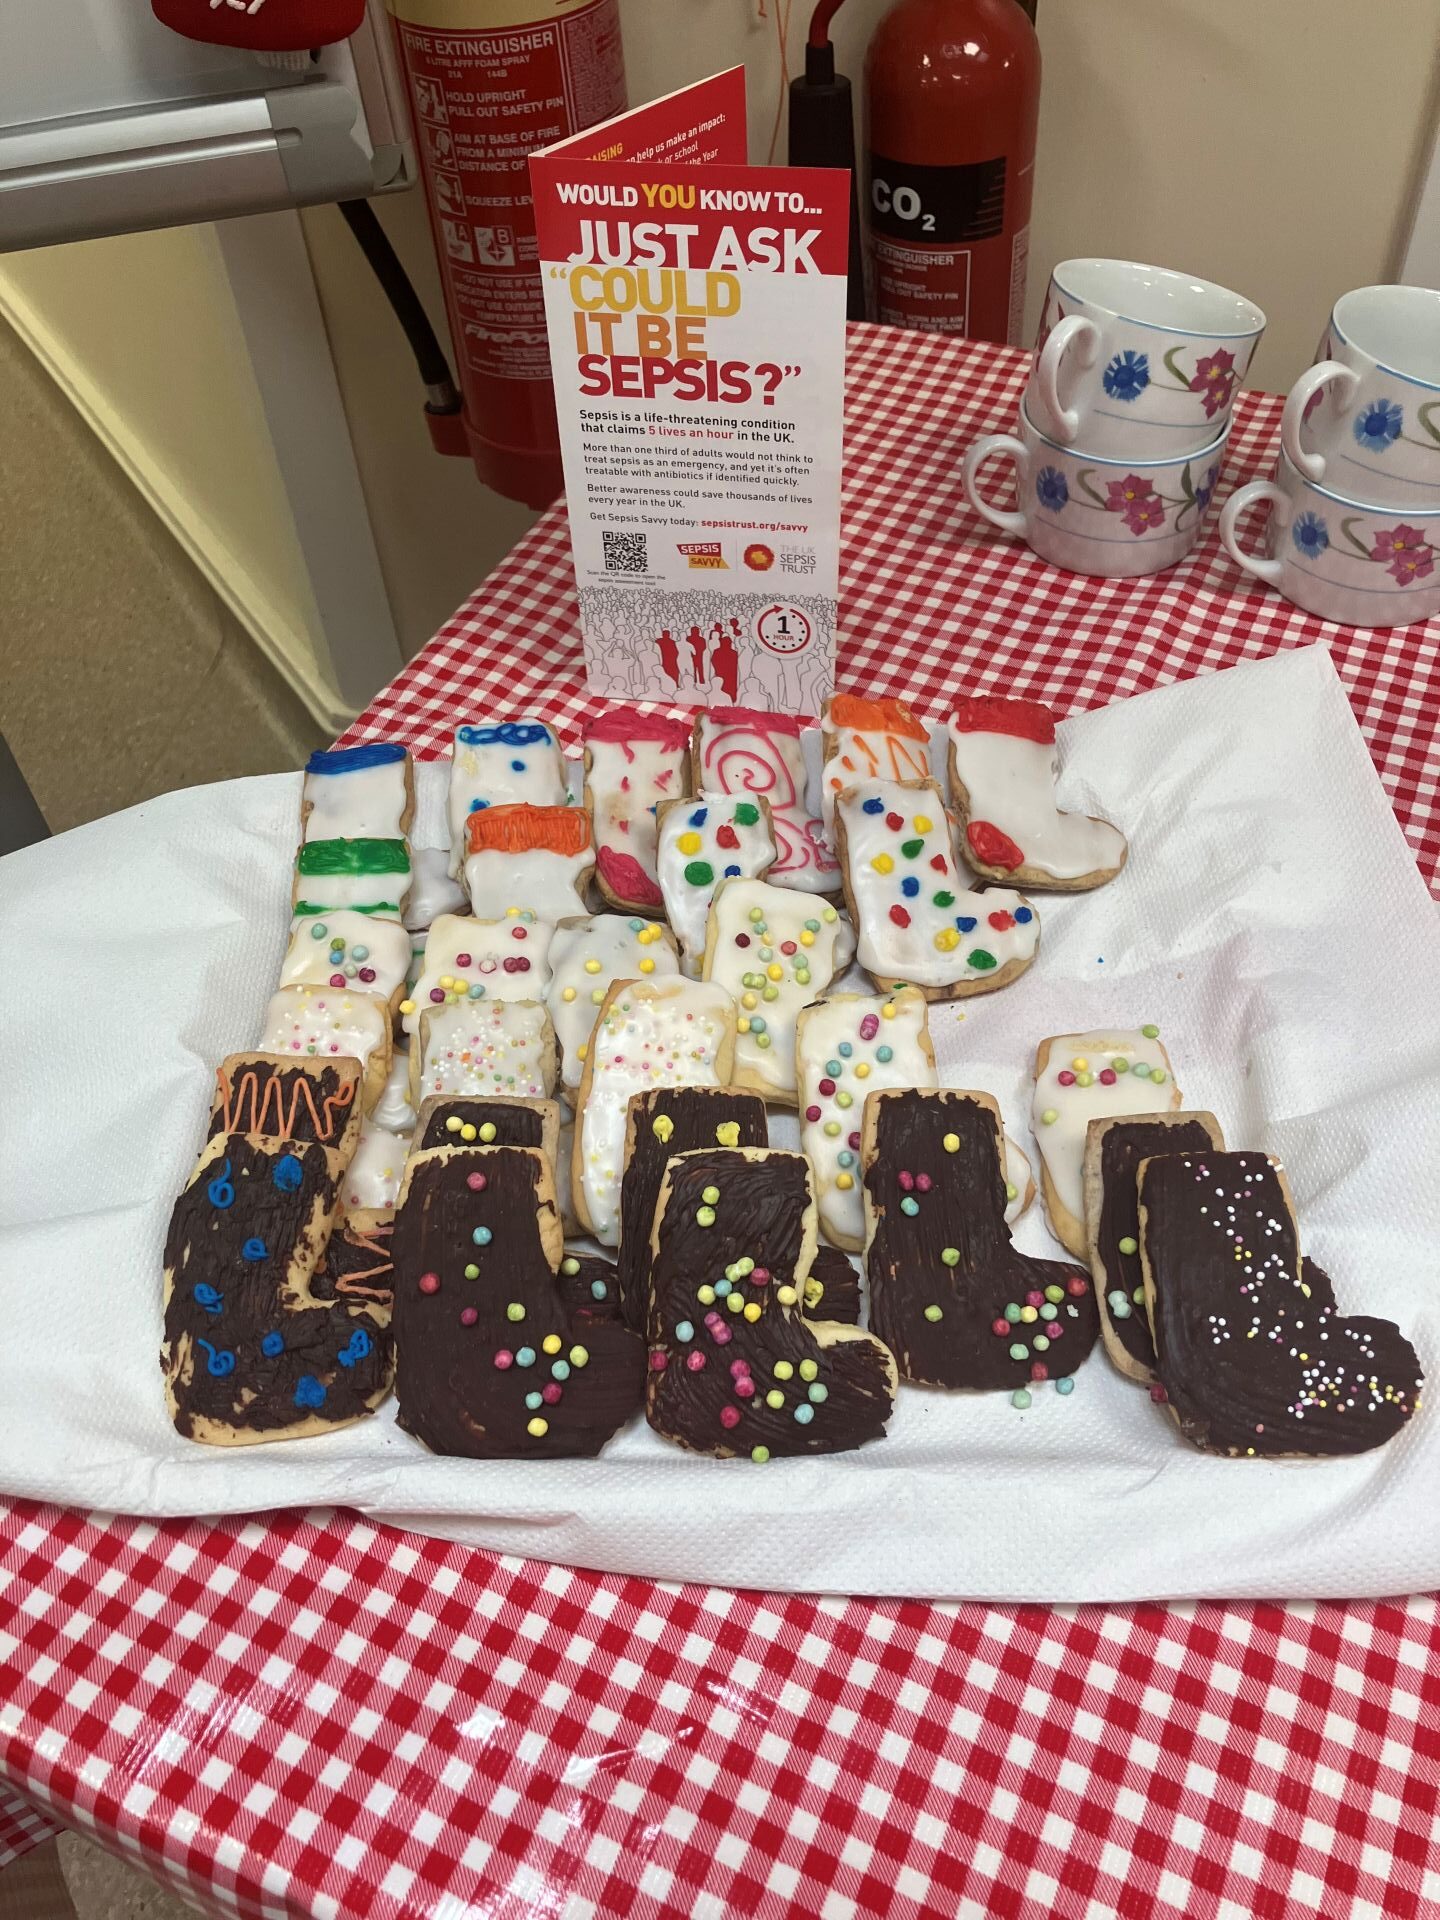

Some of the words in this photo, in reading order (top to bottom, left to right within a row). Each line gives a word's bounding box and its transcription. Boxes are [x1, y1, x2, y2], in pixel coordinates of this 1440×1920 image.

[406, 34, 432, 52] FIRE
[435, 31, 553, 56] EXTINGUISHER
[474, 59, 500, 68] FOAM
[502, 55, 530, 66] SPRAY
[446, 91, 474, 102] HOLD
[477, 89, 526, 102] UPRIGHT
[448, 105, 474, 117] PULL
[476, 106, 498, 117] OUT
[502, 101, 543, 116] SAFETY
[546, 96, 563, 109] PIN
[454, 134, 471, 144] AIM
[474, 134, 486, 144] AT
[489, 133, 518, 144] BASE
[520, 130, 535, 142] OF
[538, 126, 560, 139] FIRE
[637, 148, 653, 162] help
[656, 143, 665, 153] us
[666, 132, 686, 148] make
[688, 128, 697, 137] an
[699, 114, 726, 132] impact:
[456, 146, 484, 158] FROM
[487, 148, 495, 158] A
[586, 142, 622, 161] AISING
[675, 140, 698, 160] school
[703, 148, 718, 162] Year
[459, 161, 509, 172] DISTANCE
[511, 160, 525, 171] OF
[556, 183, 638, 207] WOULD
[641, 184, 696, 209] YOU
[700, 190, 771, 212] KNOW
[774, 192, 822, 214] TO...
[497, 229, 509, 243] B
[567, 220, 699, 268] JUST
[710, 226, 823, 275] ASK
[574, 311, 622, 356] IT
[637, 314, 708, 360] BE
[580, 410, 618, 421] Sepsis
[621, 412, 631, 421] is
[644, 413, 737, 428] life-threatening
[741, 420, 795, 430] condition
[581, 423, 604, 432] that
[608, 424, 646, 434] claims
[649, 426, 655, 435] 5
[659, 426, 686, 437] lives
[707, 429, 734, 439] hour
[737, 431, 748, 440] in
[752, 432, 770, 441] the
[774, 433, 794, 443] UK.
[583, 443, 607, 452] More
[610, 445, 631, 453] than
[655, 447, 677, 455] third
[692, 449, 722, 457] adults
[725, 451, 754, 460] would
[776, 454, 801, 463] think
[584, 455, 607, 463] treat
[610, 457, 640, 466] sepsis
[671, 460, 727, 471] emergency,
[768, 465, 782, 473] it's
[785, 466, 810, 475] often
[585, 467, 628, 476] treatable
[631, 469, 651, 477] with
[654, 470, 703, 480] antibiotics
[716, 473, 760, 483] identified
[764, 477, 799, 487] quickly.
[587, 484, 617, 493] Better
[620, 487, 671, 496] awareness
[673, 489, 699, 498] could
[726, 492, 776, 501] thousands
[779, 494, 787, 502] of
[790, 495, 812, 503] lives
[588, 496, 614, 506] every
[650, 499, 666, 507] the
[669, 500, 686, 508] UK.
[590, 512, 606, 520] Get
[609, 513, 639, 523] Sepsis
[641, 515, 668, 526] Savvy
[670, 518, 699, 527] today:
[701, 520, 808, 533] sepsistrust.org/savvy
[680, 544, 719, 554] SEPSIS
[691, 556, 721, 568] SAVVY
[780, 554, 816, 565] SEPSIS
[780, 564, 816, 574] TRUST
[778, 616, 790, 634] 1
